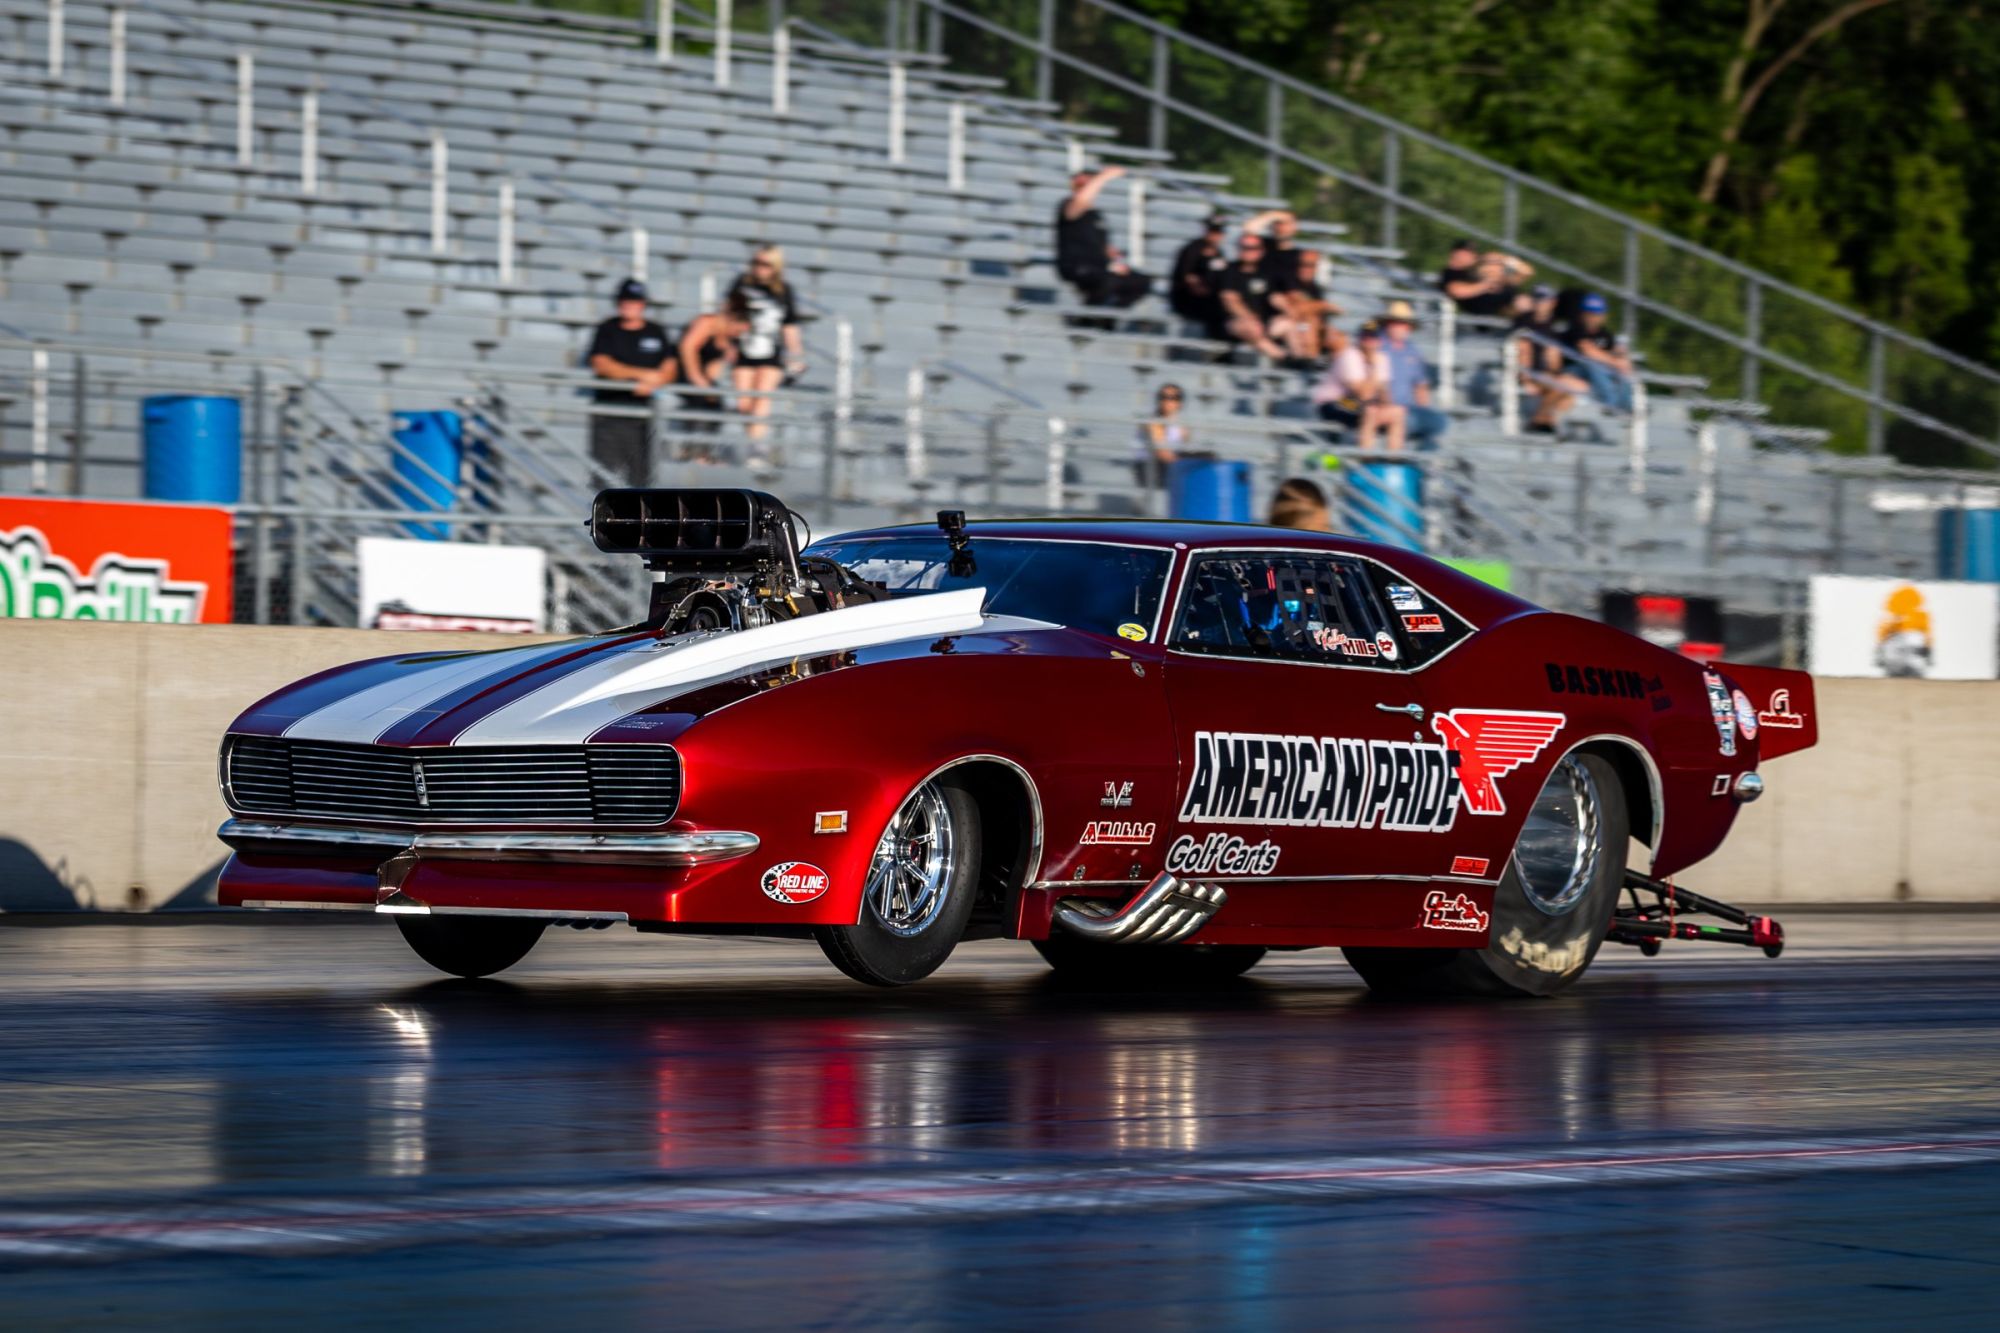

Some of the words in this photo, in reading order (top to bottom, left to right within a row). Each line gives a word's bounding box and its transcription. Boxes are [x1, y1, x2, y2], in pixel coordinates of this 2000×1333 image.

[1341, 638, 1379, 657] Mills
[1544, 662, 1645, 699] BASKIN
[1181, 733, 1365, 826] AMERICAN
[1364, 741, 1461, 830] PRIDE
[779, 874, 801, 888] RED
[800, 875, 825, 889] LINE
